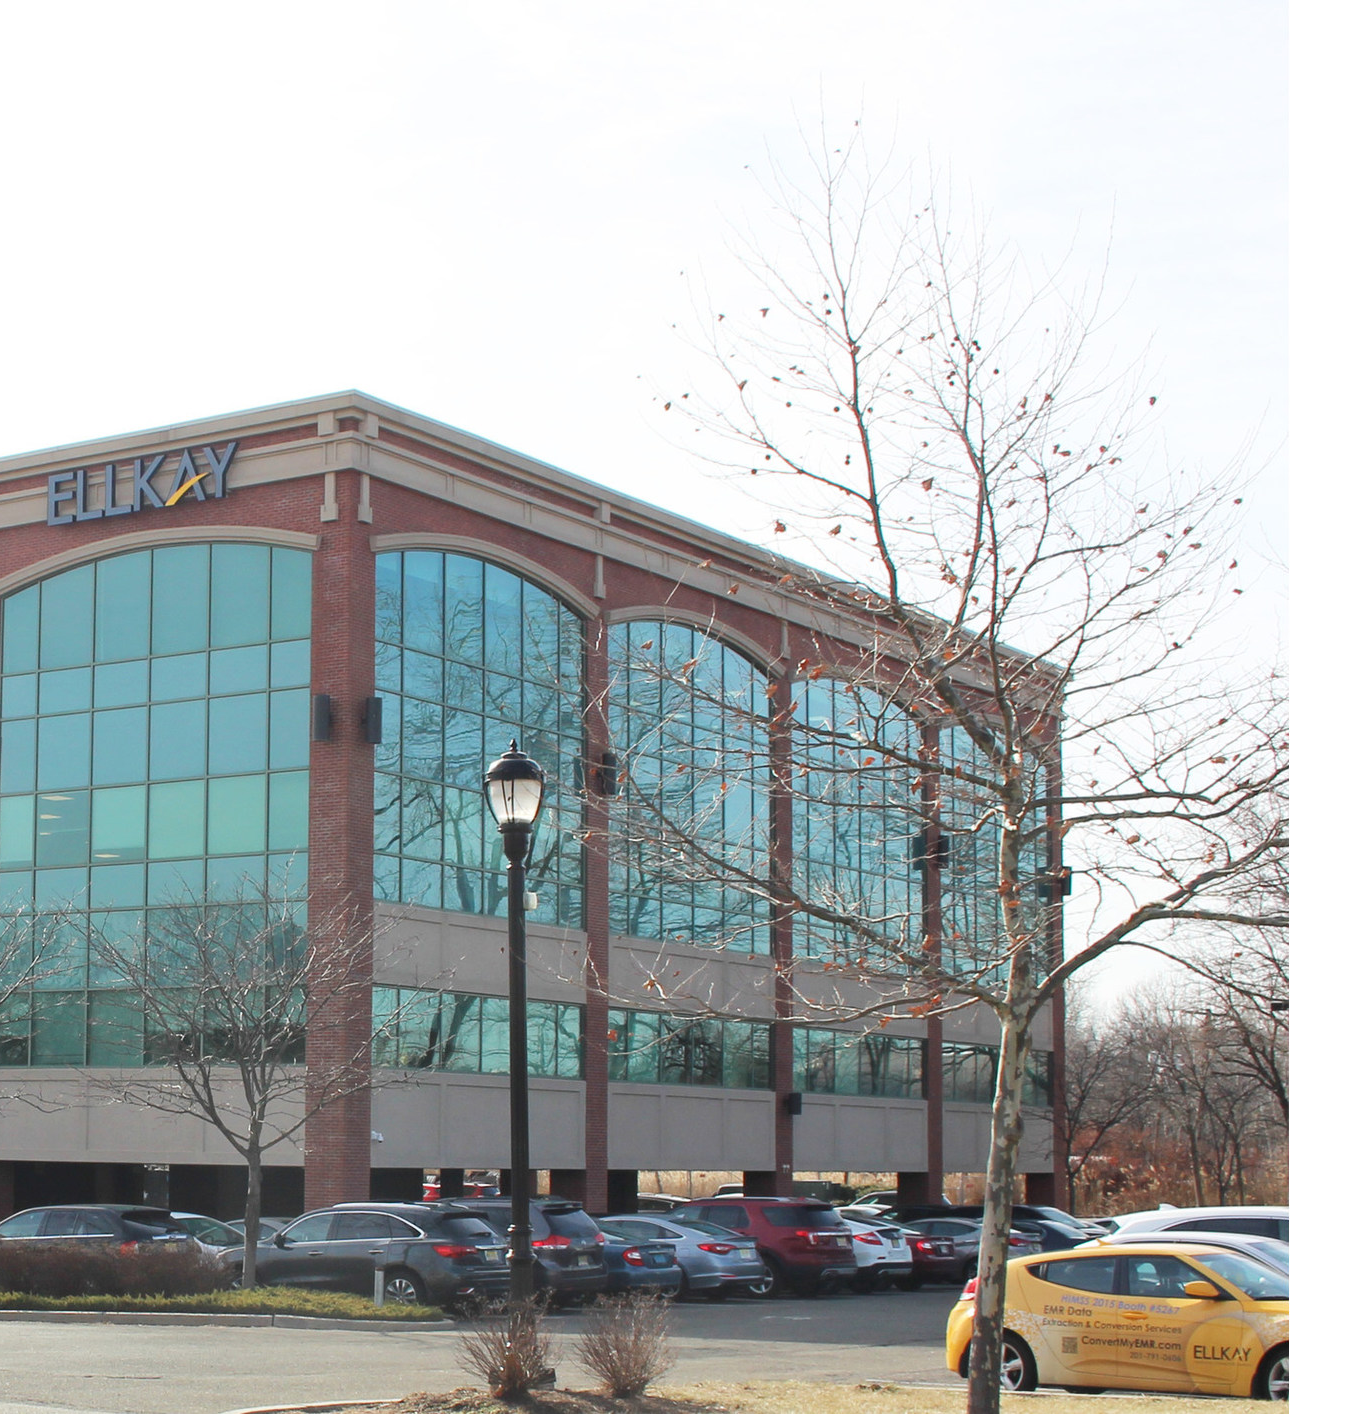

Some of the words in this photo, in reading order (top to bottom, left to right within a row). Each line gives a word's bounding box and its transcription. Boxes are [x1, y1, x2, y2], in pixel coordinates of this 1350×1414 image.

[47, 441, 240, 526] ELLKAY
[1043, 1305, 1065, 1316] EMR
[1067, 1306, 1092, 1317] Data
[1061, 1294, 1090, 1306] HIMSS
[1092, 1298, 1115, 1309] 2015
[1118, 1301, 1146, 1311] Booth
[1150, 1304, 1180, 1314] #5267
[1042, 1317, 1083, 1328] Extraction
[1085, 1320, 1091, 1328] &
[1094, 1320, 1143, 1331] Conversion
[1145, 1323, 1182, 1334] Services
[1081, 1336, 1182, 1350] ConvertMyEMR.com
[1193, 1345, 1252, 1361] ELLKAY
